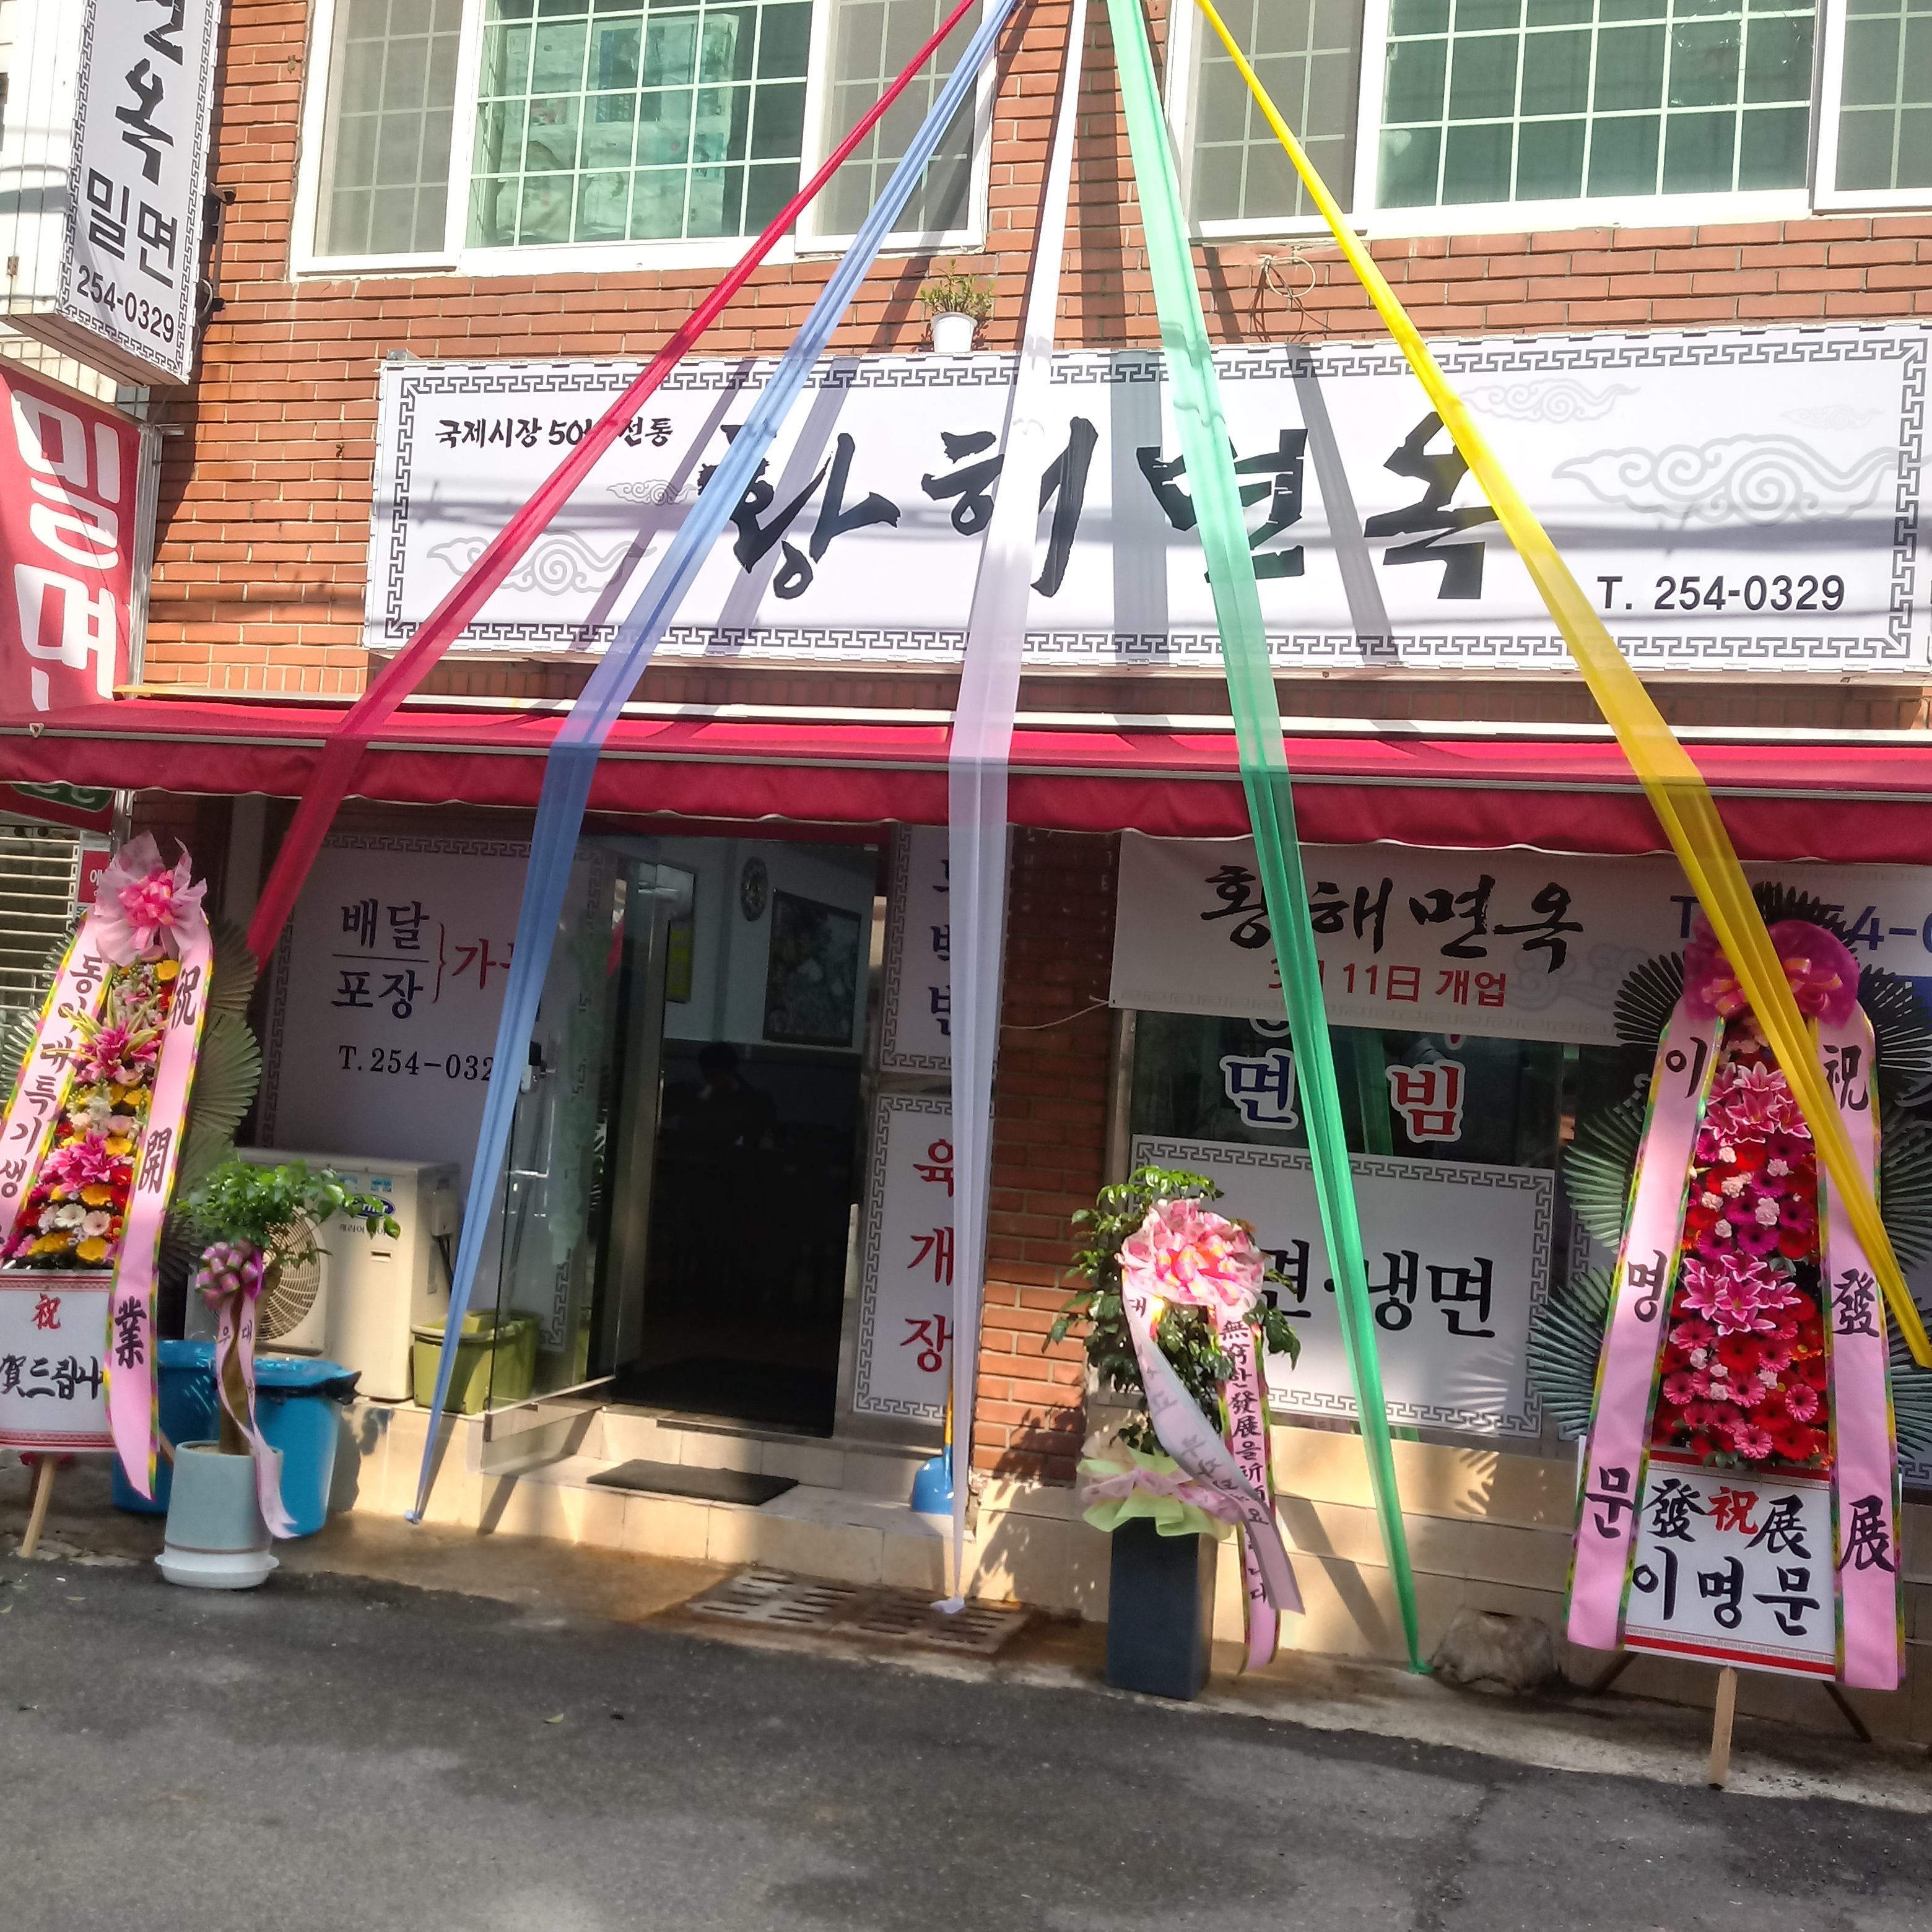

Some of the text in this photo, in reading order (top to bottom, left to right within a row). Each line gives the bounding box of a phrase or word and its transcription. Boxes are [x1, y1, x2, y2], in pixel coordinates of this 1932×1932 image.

[86, 167, 178, 289] 밀면
[77, 264, 175, 343] 254-0329
[435, 417, 542, 448] 국제시장
[549, 418, 593, 445] 50
[11, 389, 120, 711] 밀면
[1598, 575, 1845, 611] T. 254-0329
[342, 899, 430, 950] 배달
[1201, 865, 1585, 974] 황해면옥
[452, 938, 515, 990] 가
[1435, 970, 1507, 1008] 개업
[331, 969, 424, 1019] 포장
[32, 1292, 61, 1330] 祝
